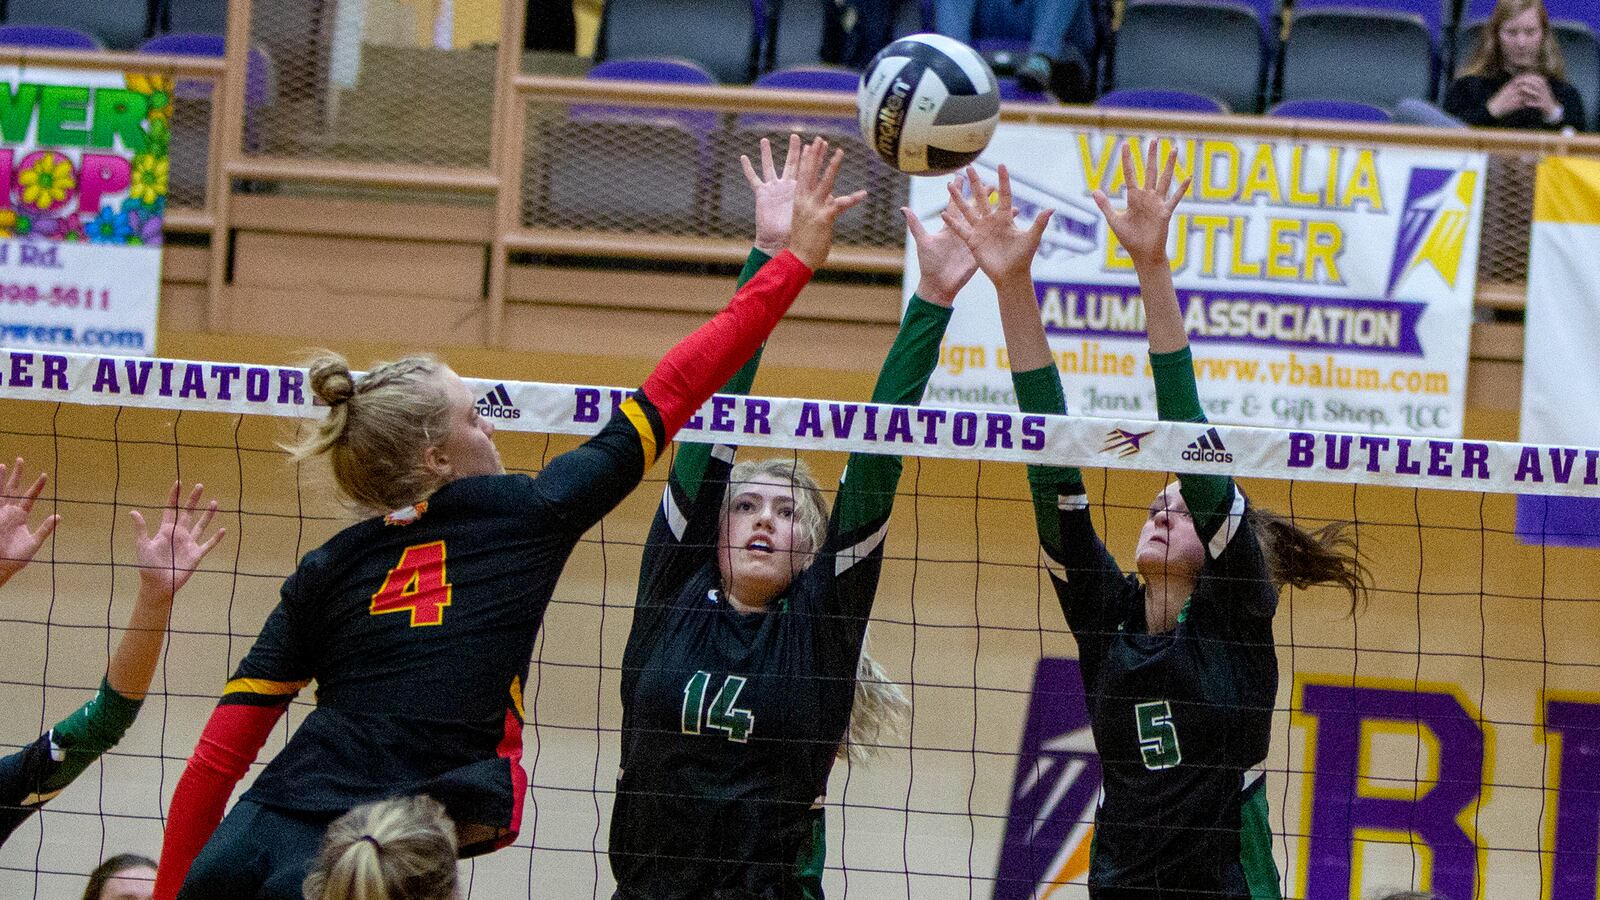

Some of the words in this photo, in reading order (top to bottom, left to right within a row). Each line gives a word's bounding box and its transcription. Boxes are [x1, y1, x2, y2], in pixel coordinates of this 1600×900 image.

[877, 77, 911, 157] molten
[0, 148, 132, 214] OP
[1077, 133, 1386, 211] VANDALIA
[20, 244, 63, 269] Rd.
[1041, 288, 1147, 331] ALUM
[1185, 299, 1399, 347] ASSOCIATION
[938, 338, 986, 375] ign
[995, 347, 1012, 369] u
[1053, 340, 1136, 377] nline
[0, 352, 69, 391] ER
[92, 358, 325, 407] AVIATOR
[795, 401, 1046, 451] AVIATORS
[1181, 449, 1233, 463] adidas
[1287, 432, 1490, 480] BUTLER
[1514, 446, 1600, 486] AVI
[369, 540, 453, 627] 4
[681, 670, 755, 744] 14
[1135, 700, 1182, 771] 5
